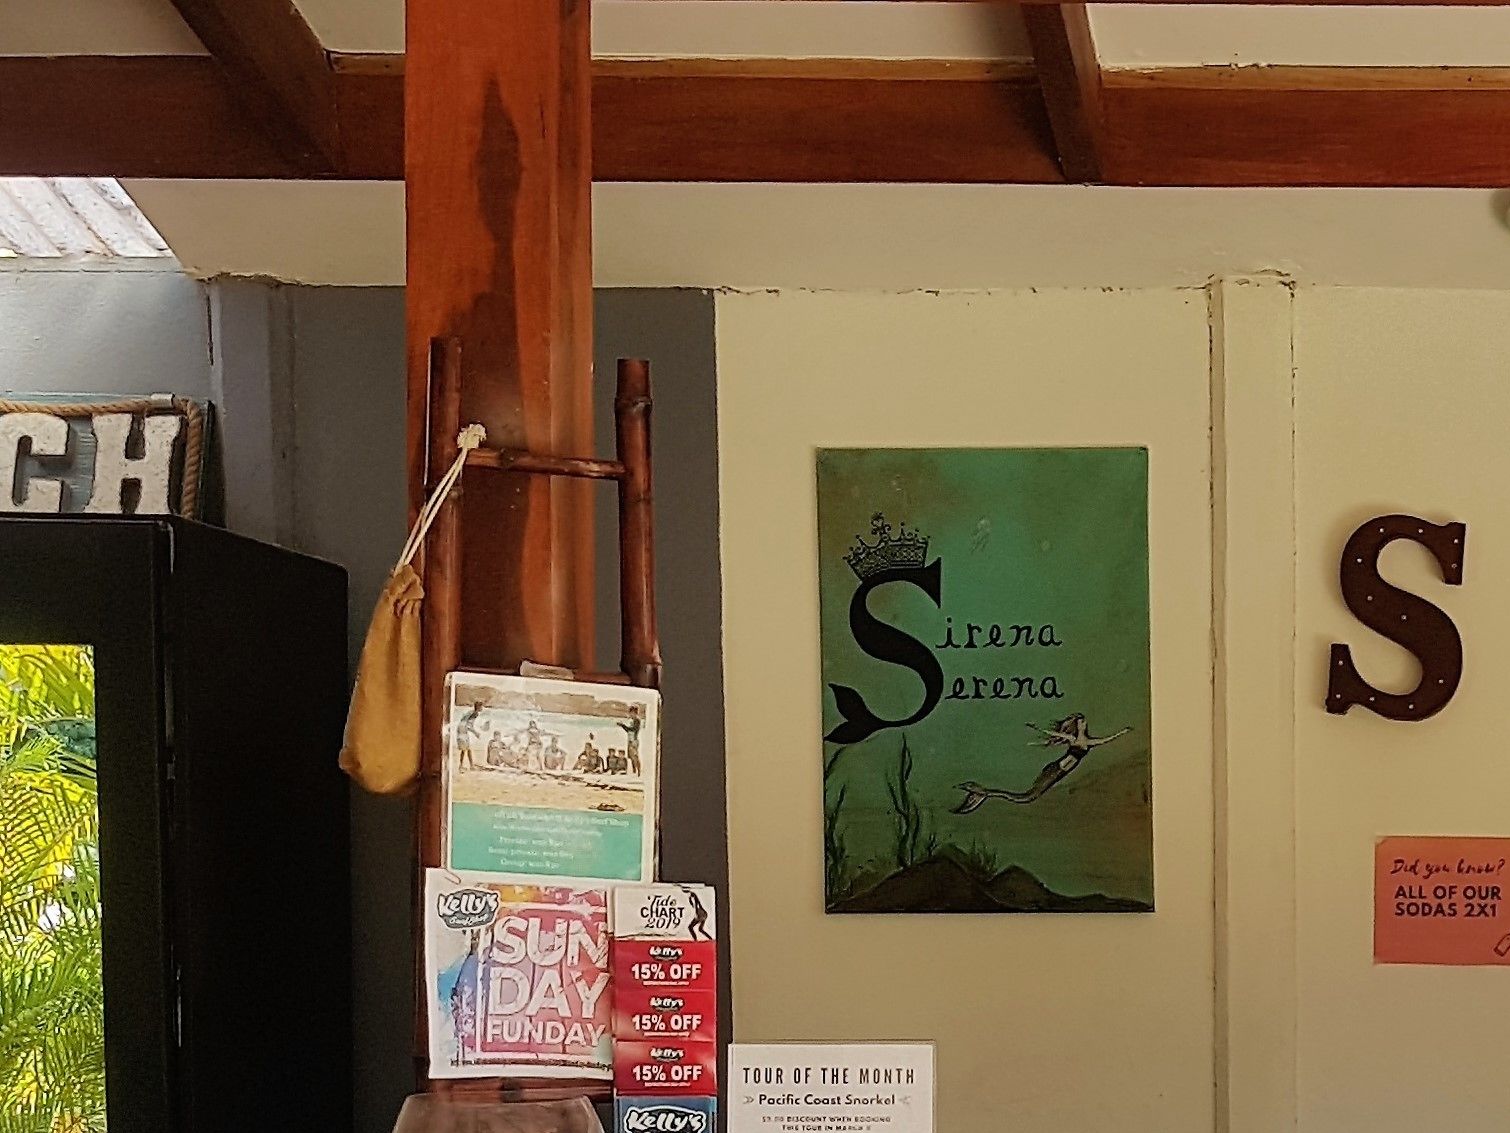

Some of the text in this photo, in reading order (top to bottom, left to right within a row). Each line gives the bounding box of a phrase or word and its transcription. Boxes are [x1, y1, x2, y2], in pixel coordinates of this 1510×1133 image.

[1390, 858, 1420, 875] Did
[1422, 863, 1449, 879] you
[1394, 885, 1502, 900] ALL OF OUR
[438, 893, 498, 915] Kelly's
[1394, 902, 1497, 917] SODAS 2X1
[641, 907, 684, 919] CHART
[644, 917, 681, 929] 2019
[489, 916, 609, 969] SUN
[631, 963, 702, 980] 15% OFF
[488, 967, 611, 1019] DAY
[632, 1014, 702, 1031] 15% OFF
[486, 1019, 606, 1047] FUNDAY
[632, 1065, 702, 1081] 15% OFF
[743, 1067, 914, 1084] TOUR OF THE MONTH
[759, 1093, 895, 1105] Pacific Coast Snorkel
[627, 1111, 702, 1132] Kelly's
